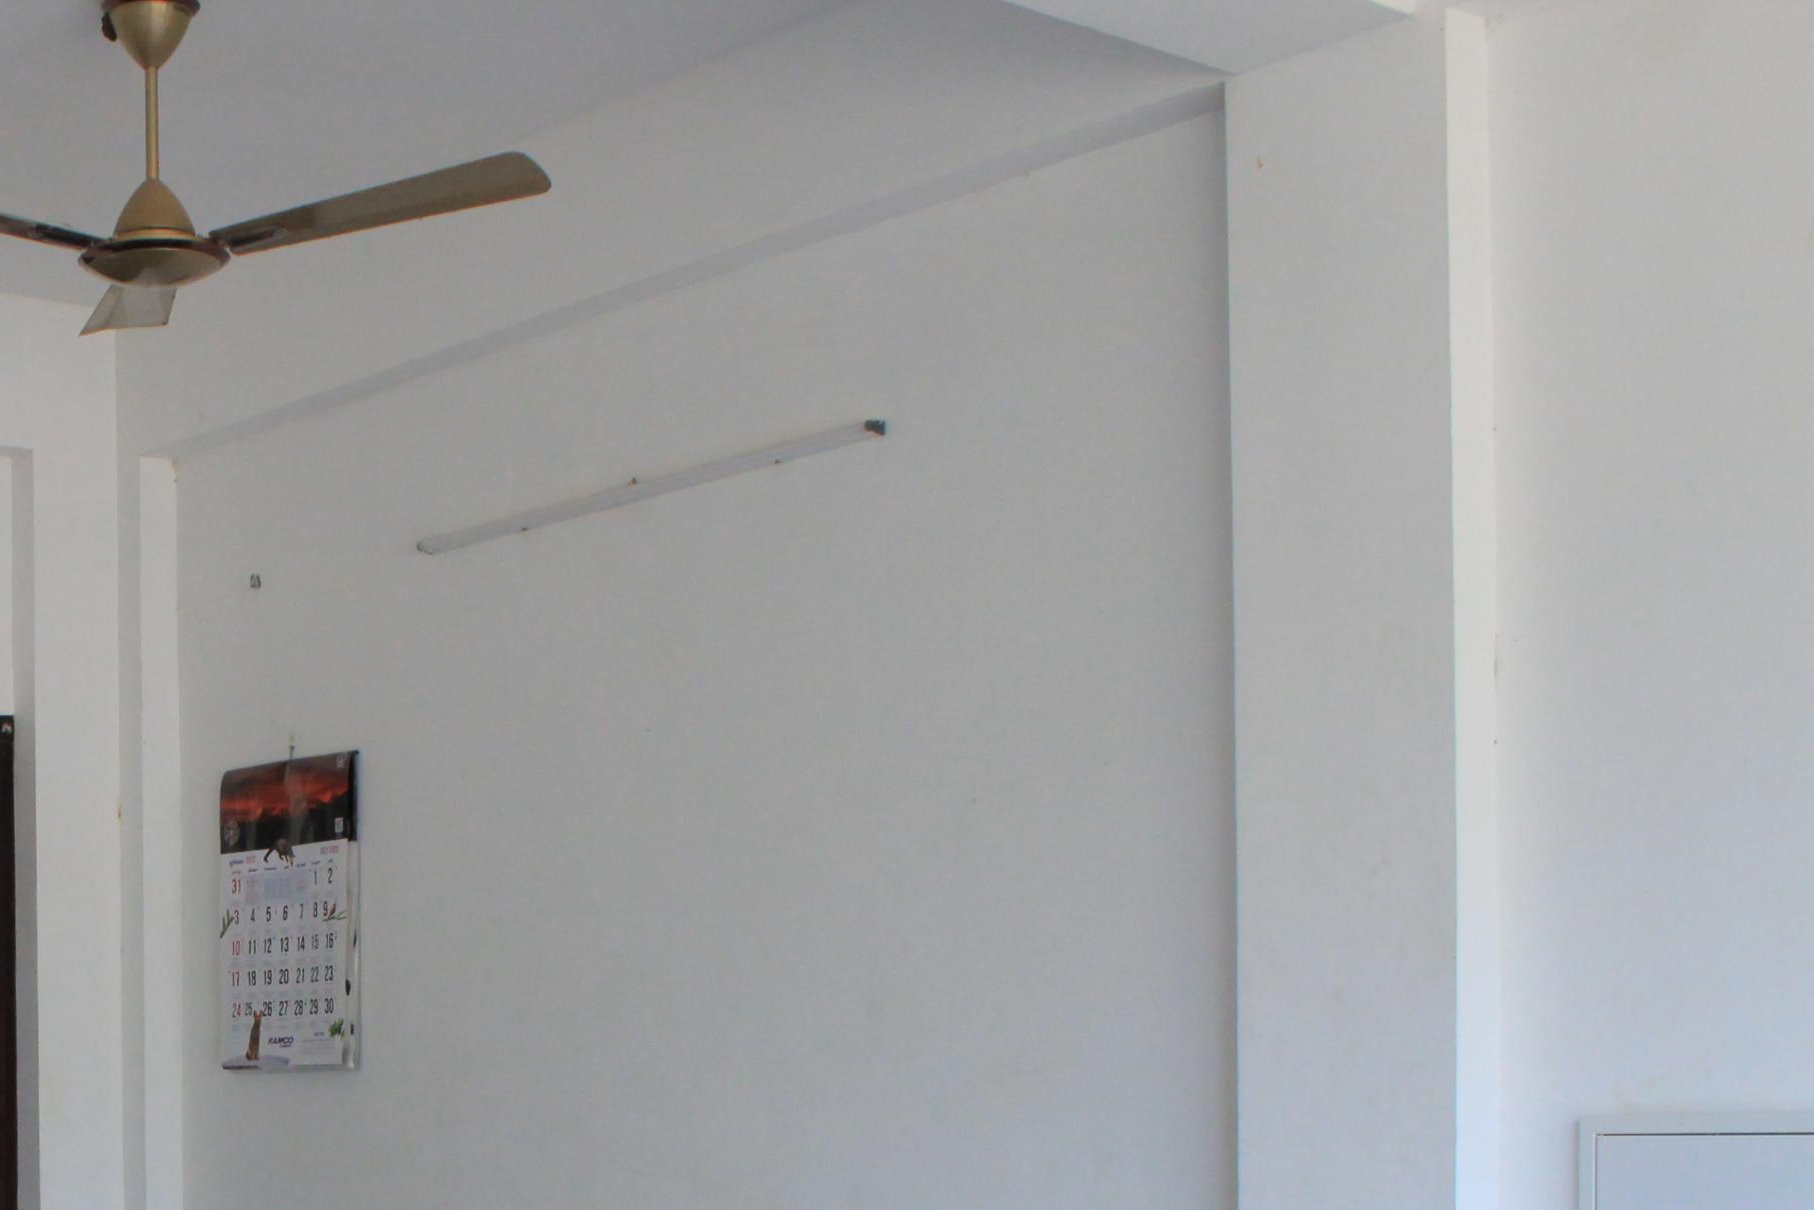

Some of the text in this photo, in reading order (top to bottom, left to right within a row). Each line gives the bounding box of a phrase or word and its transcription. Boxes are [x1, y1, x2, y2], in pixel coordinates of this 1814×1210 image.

[327, 868, 333, 884] 2
[234, 910, 239, 924] 3
[266, 906, 271, 922] 5
[282, 904, 288, 920] 6
[232, 932, 334, 956] 10 11 12 13 14 15 16
[232, 965, 334, 986] 17 18 19 20 21 22 23
[232, 997, 334, 1018] 24 25 26 27 28 29 30
